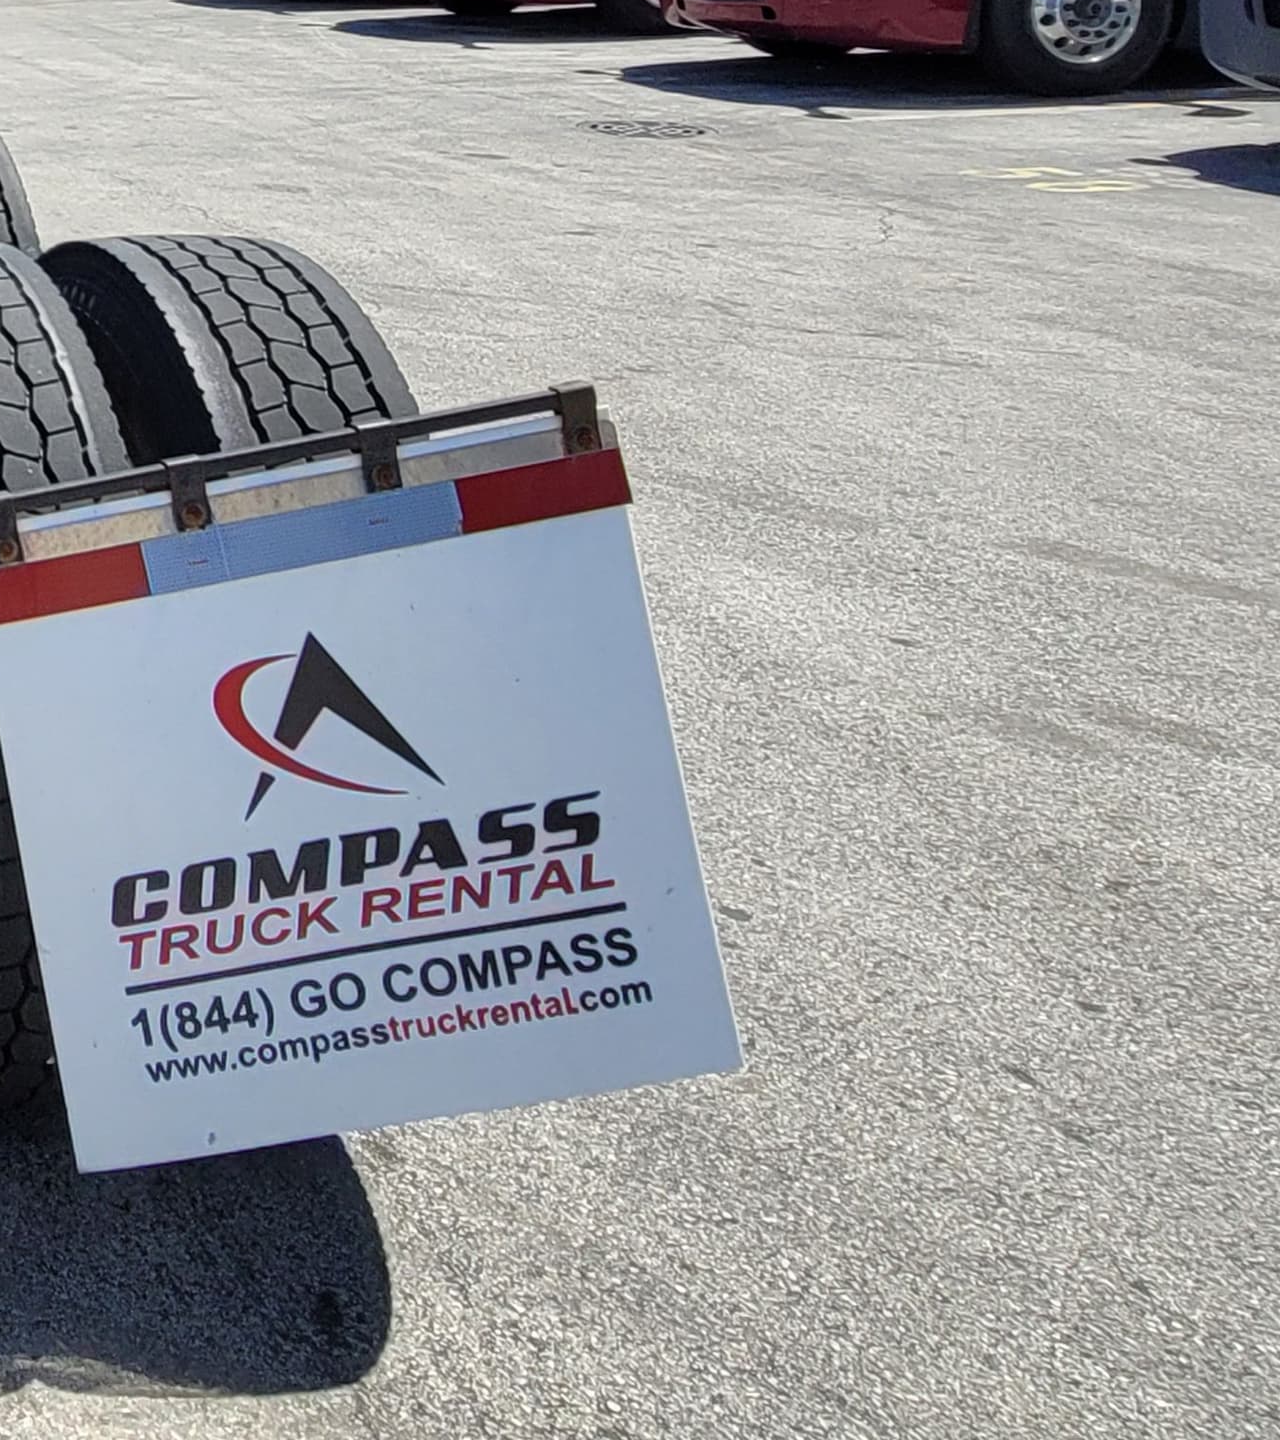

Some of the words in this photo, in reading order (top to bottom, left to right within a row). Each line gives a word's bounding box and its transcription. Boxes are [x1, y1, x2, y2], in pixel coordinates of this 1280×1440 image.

[111, 790, 601, 928] COMPASS
[119, 896, 340, 970] TRUCK
[360, 853, 616, 928] RENTAL
[131, 987, 275, 1052] 1(844)
[289, 971, 367, 1019] GO
[381, 927, 639, 1004] COMPASS
[144, 980, 653, 1083] www.compasstruckrental.com
